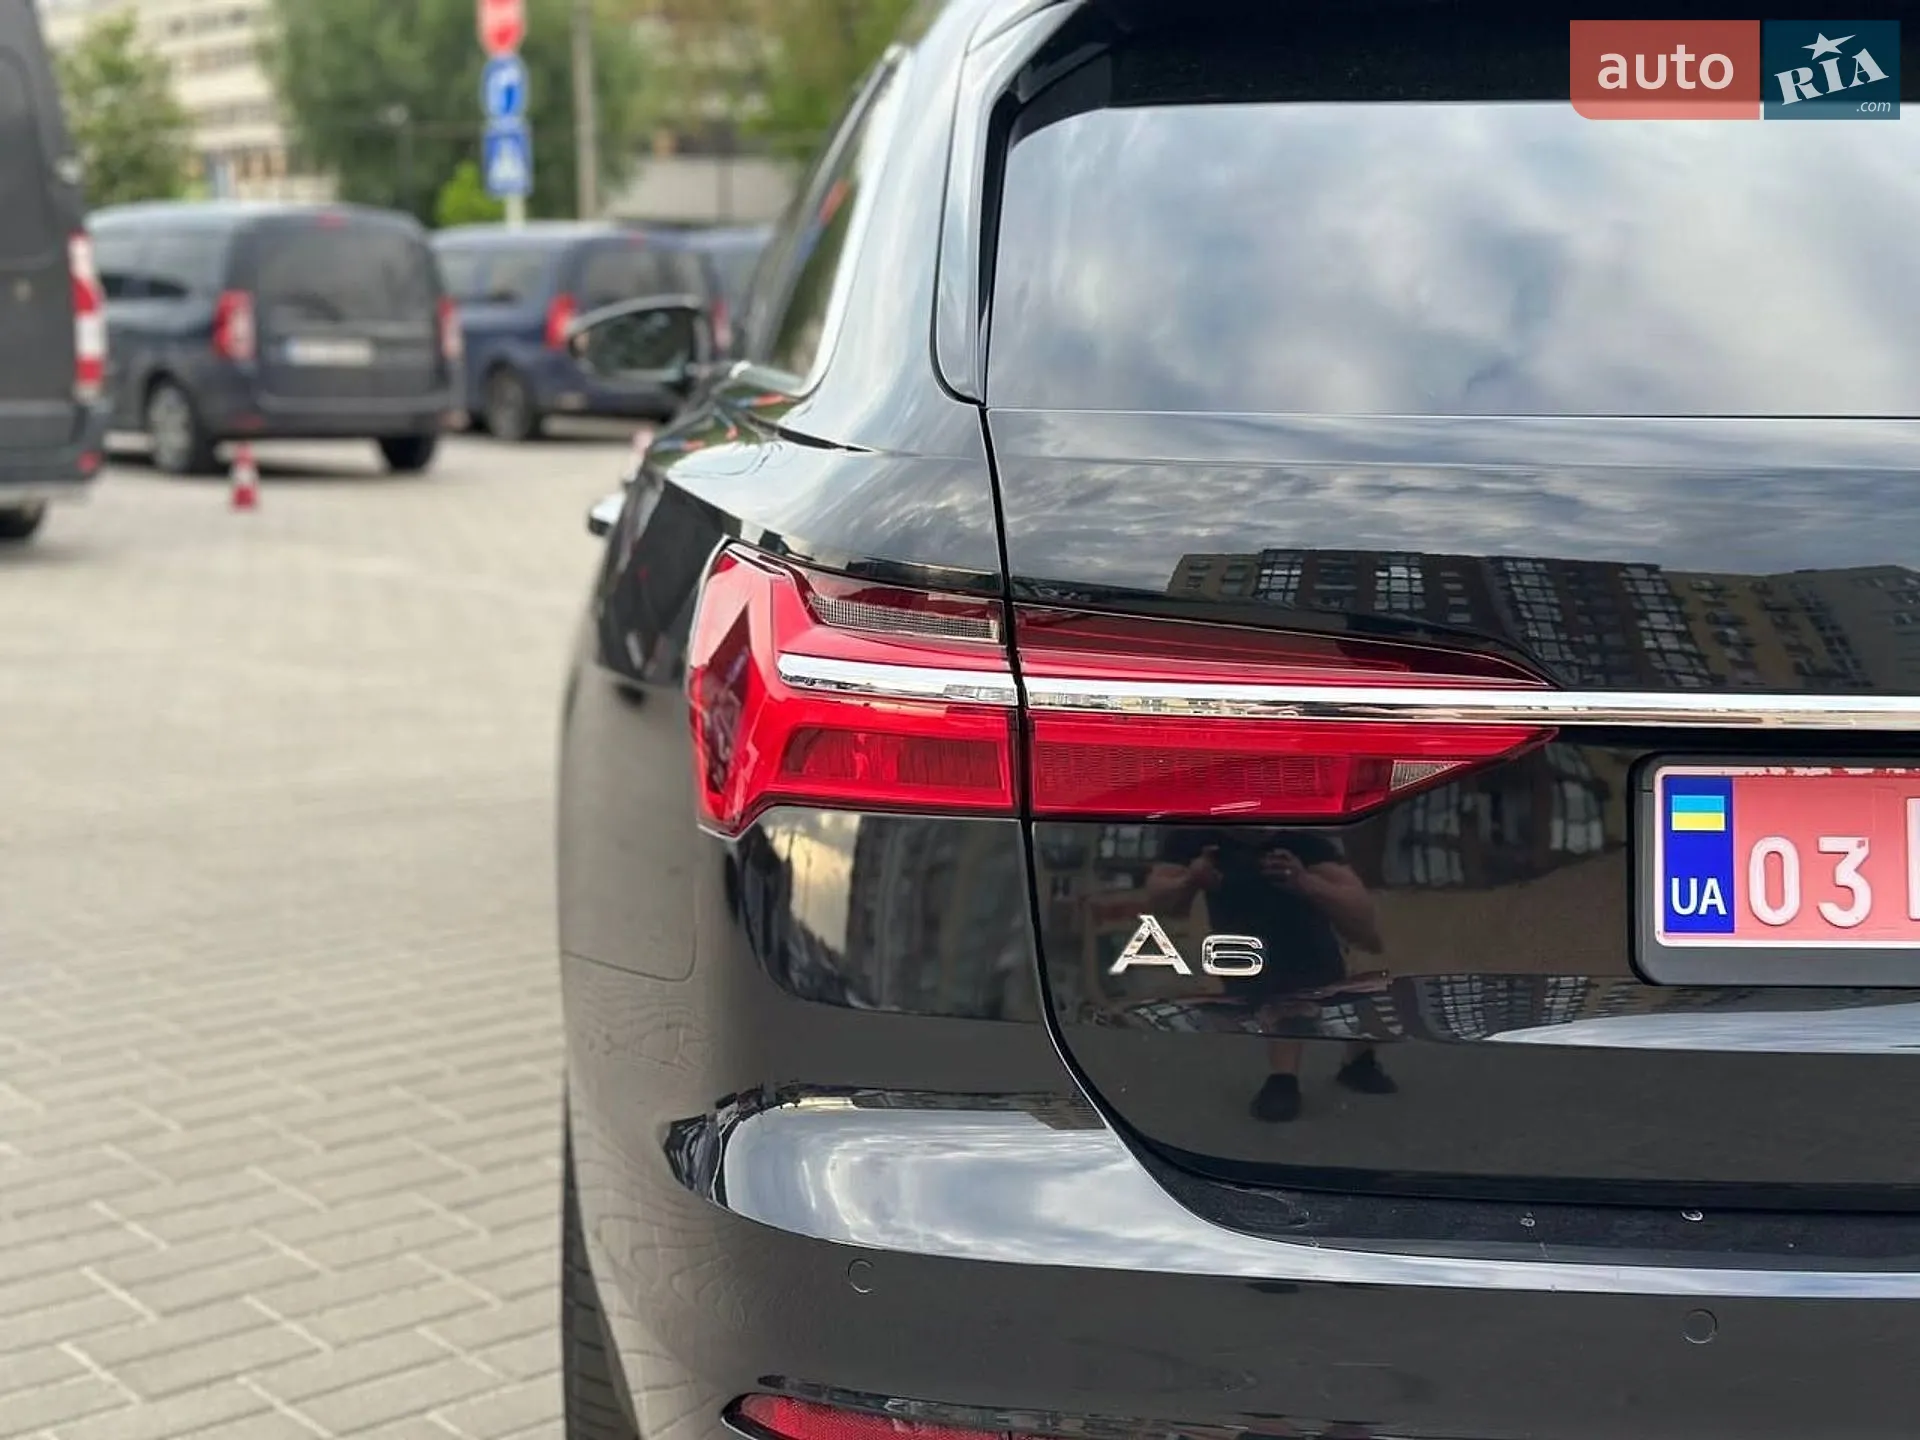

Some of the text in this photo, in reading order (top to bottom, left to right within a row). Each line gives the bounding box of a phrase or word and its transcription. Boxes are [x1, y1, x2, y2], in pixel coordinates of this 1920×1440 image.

[1671, 877, 1728, 915] UA
[1748, 836, 1872, 929] 03
[1108, 914, 1264, 977] A6
